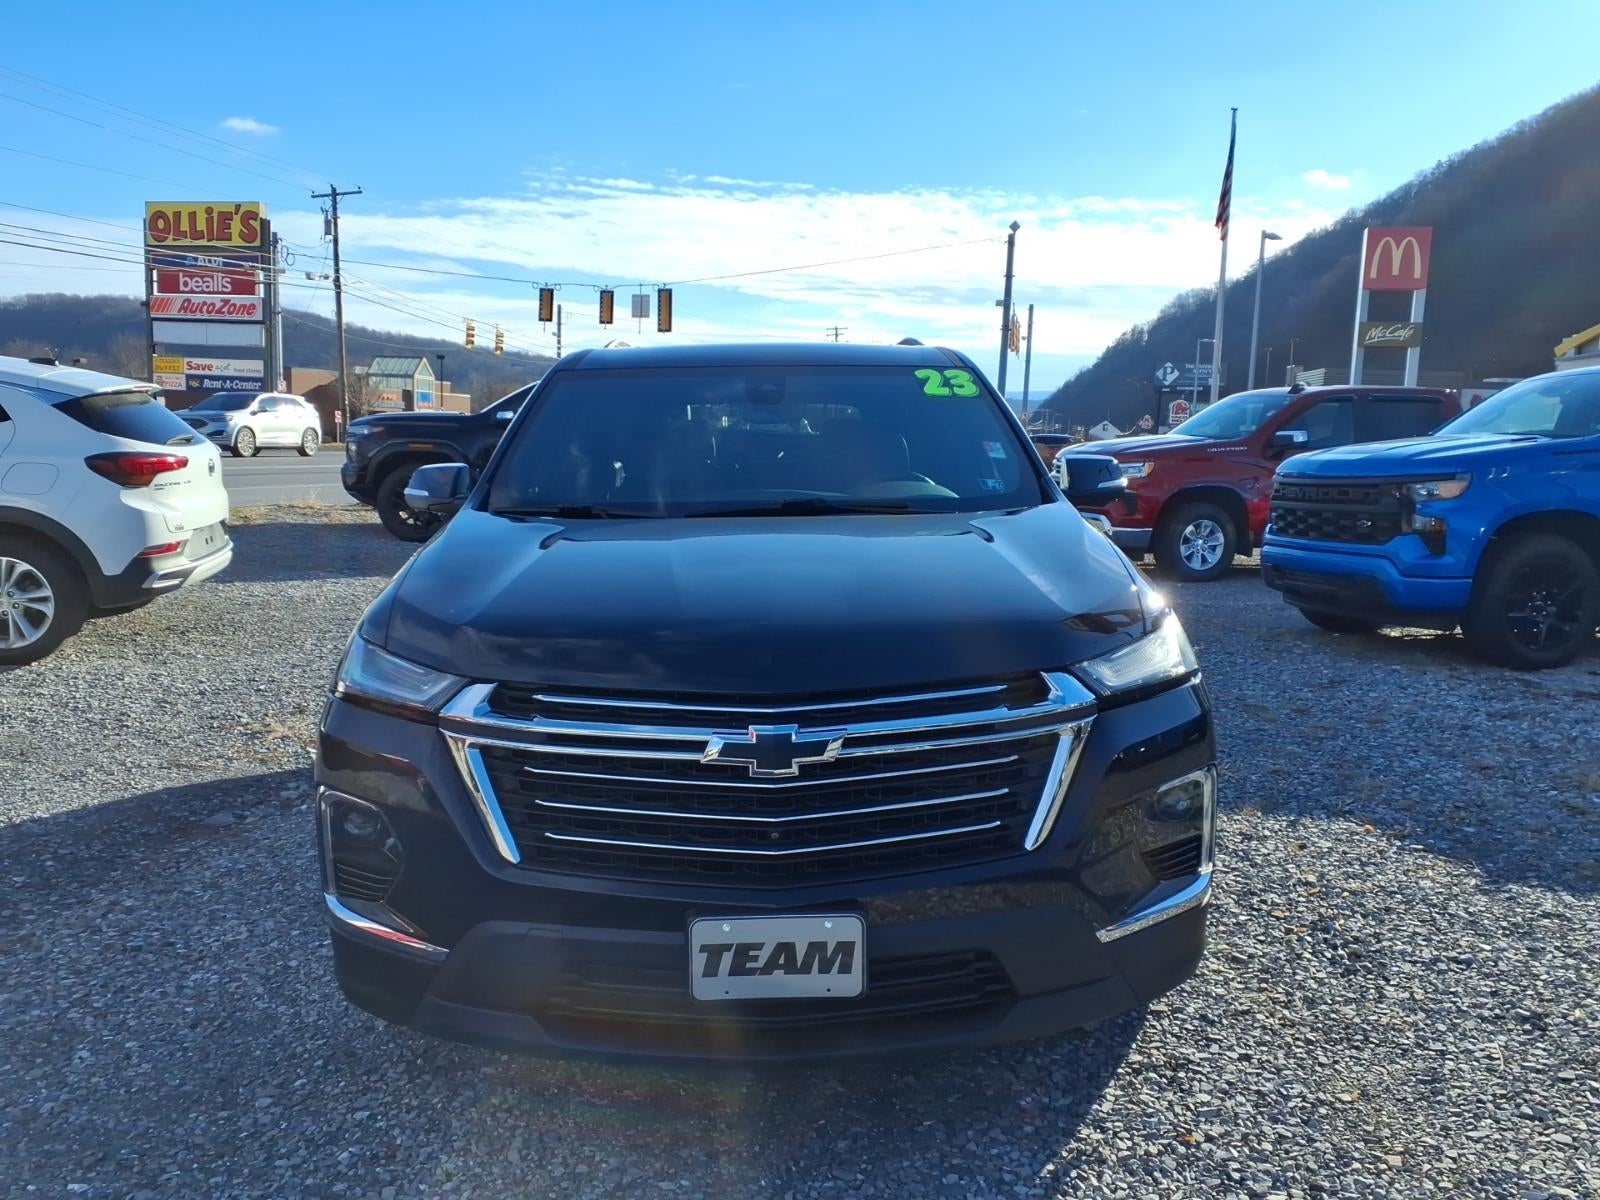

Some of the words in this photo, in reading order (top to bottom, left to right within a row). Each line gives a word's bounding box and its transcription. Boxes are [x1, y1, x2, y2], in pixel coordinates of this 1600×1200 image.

[179, 271, 232, 292] bealls
[178, 298, 257, 316] AutoZone
[186, 361, 214, 372] Save
[914, 368, 981, 397] 23
[698, 940, 857, 978] TEAM
